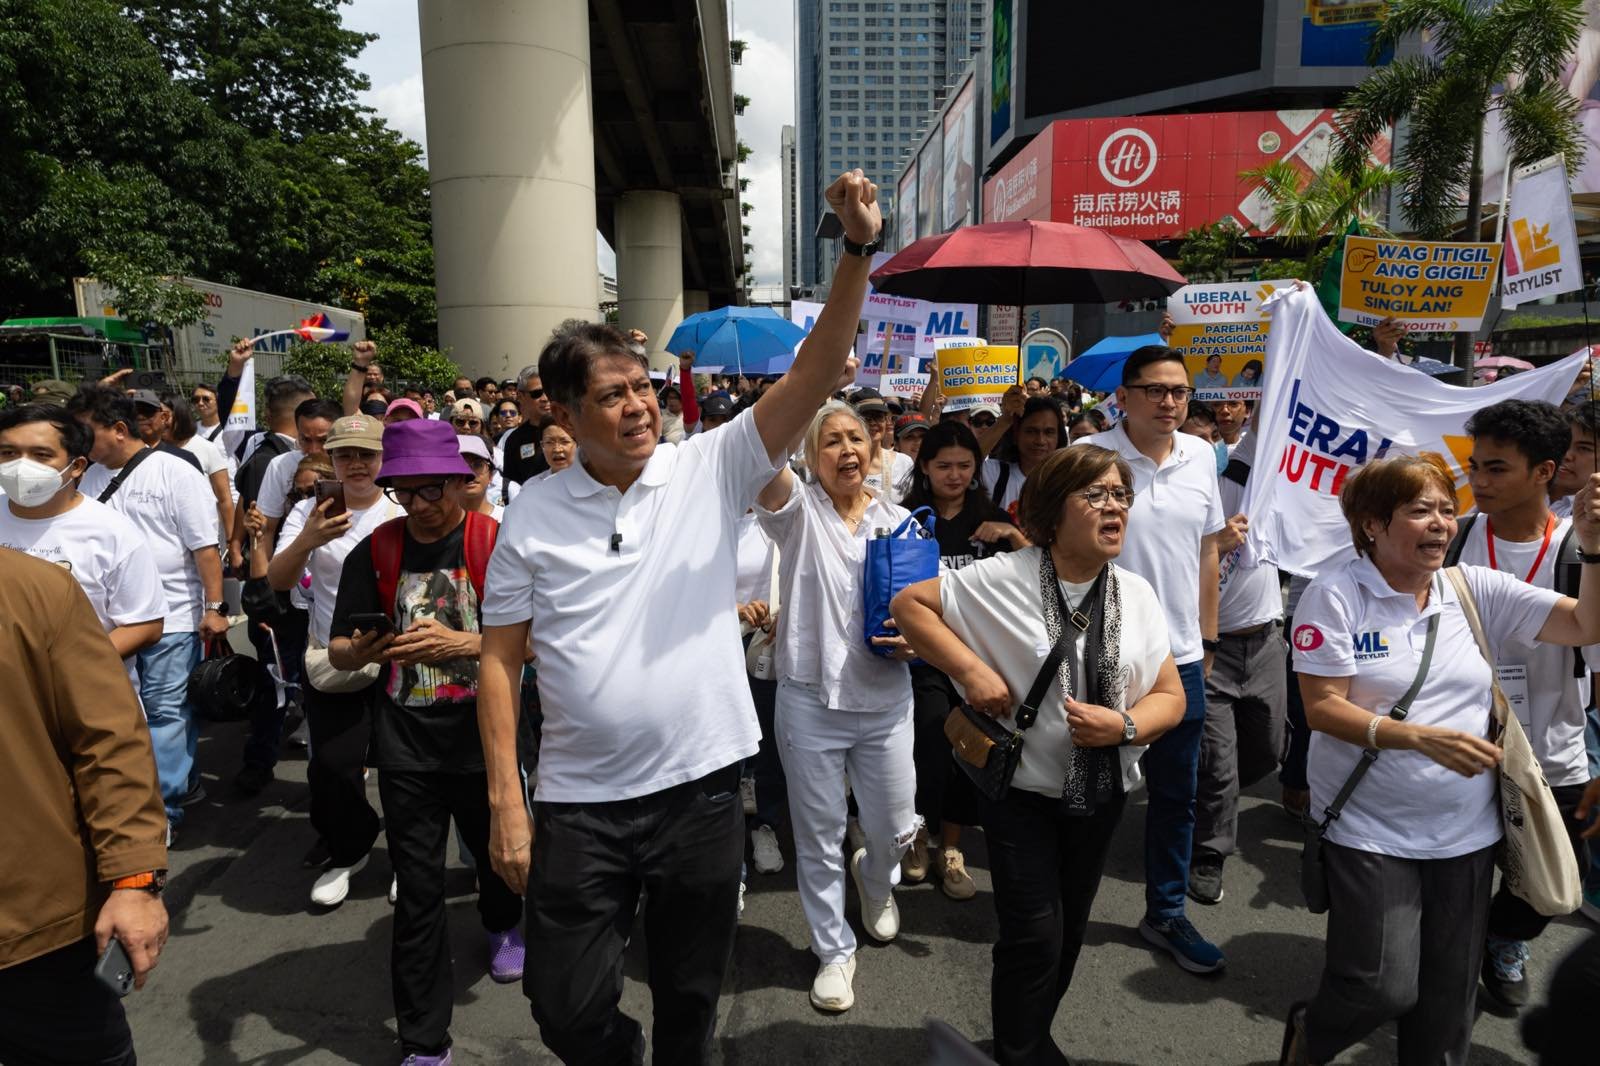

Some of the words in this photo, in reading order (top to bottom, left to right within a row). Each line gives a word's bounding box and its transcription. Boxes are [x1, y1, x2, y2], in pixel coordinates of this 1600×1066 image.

[1111, 140, 1144, 175] Hi
[1073, 190, 1181, 213] 海底捞火锅
[1073, 214, 1130, 227] Haidilao
[1131, 213, 1155, 225] Hot
[1156, 212, 1180, 225] Pot
[1377, 244, 1427, 260] WAG
[1433, 247, 1493, 262] ITIGIL
[1375, 263, 1423, 279] ANG
[1425, 266, 1488, 280] GIGIL!
[1361, 280, 1418, 297] TULOY
[1421, 285, 1464, 298] ANG
[1503, 269, 1562, 296] ARTYLIST
[869, 296, 917, 309] PARTYLIST
[1184, 290, 1252, 304] LIBERAL
[1190, 303, 1245, 315] YOUTH
[1364, 297, 1453, 313] SINGILAN!
[925, 311, 969, 335] ML
[1205, 324, 1259, 334] PAREHAS
[1356, 315, 1383, 326] LIBE
[1402, 320, 1446, 331] YOUTH
[1190, 346, 1227, 355] PATAS
[944, 367, 972, 376] GIGIL
[975, 365, 1002, 373] KAMI
[1004, 365, 1017, 373] SA
[944, 377, 975, 387] NEPO
[977, 376, 1016, 384] BABIES
[952, 397, 982, 405] LIBERAL
[1192, 392, 1226, 400] BERAL
[1227, 391, 1263, 400] YOUTH
[1353, 631, 1389, 653] ML
[1354, 652, 1390, 660] ARTYLIST
